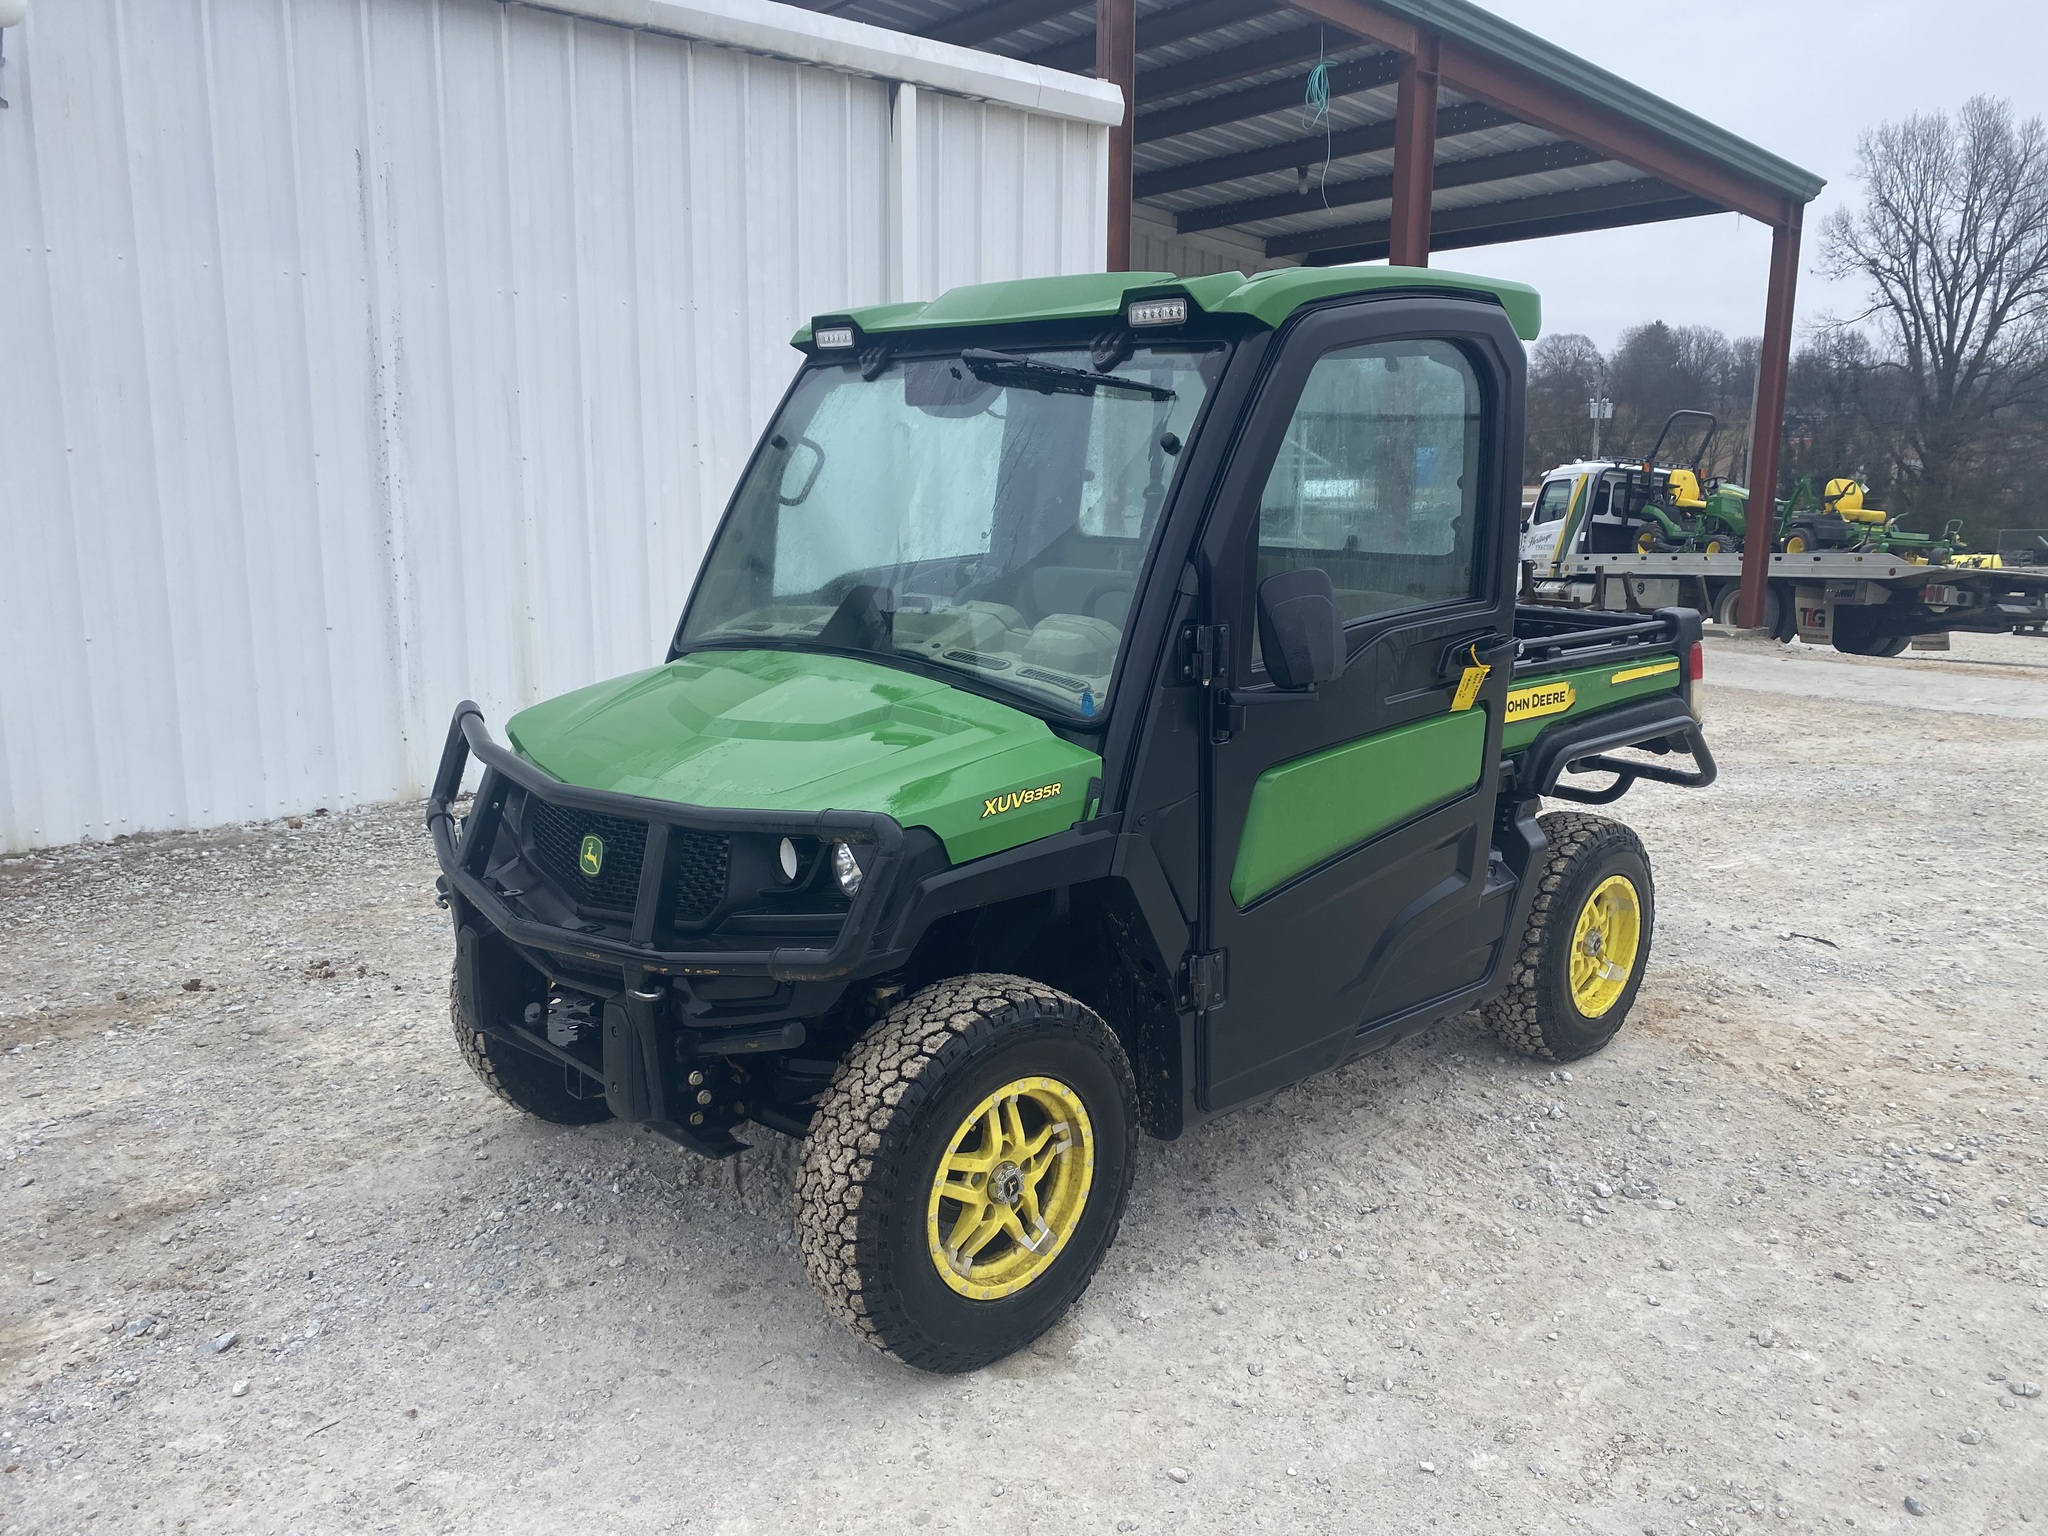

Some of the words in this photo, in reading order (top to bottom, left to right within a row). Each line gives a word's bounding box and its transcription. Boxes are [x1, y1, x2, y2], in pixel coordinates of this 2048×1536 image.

[1800, 607, 1826, 628] TLG
[1507, 697, 1530, 713] OHN
[1531, 690, 1566, 708] DEERE
[979, 782, 1062, 820] XUV835R
